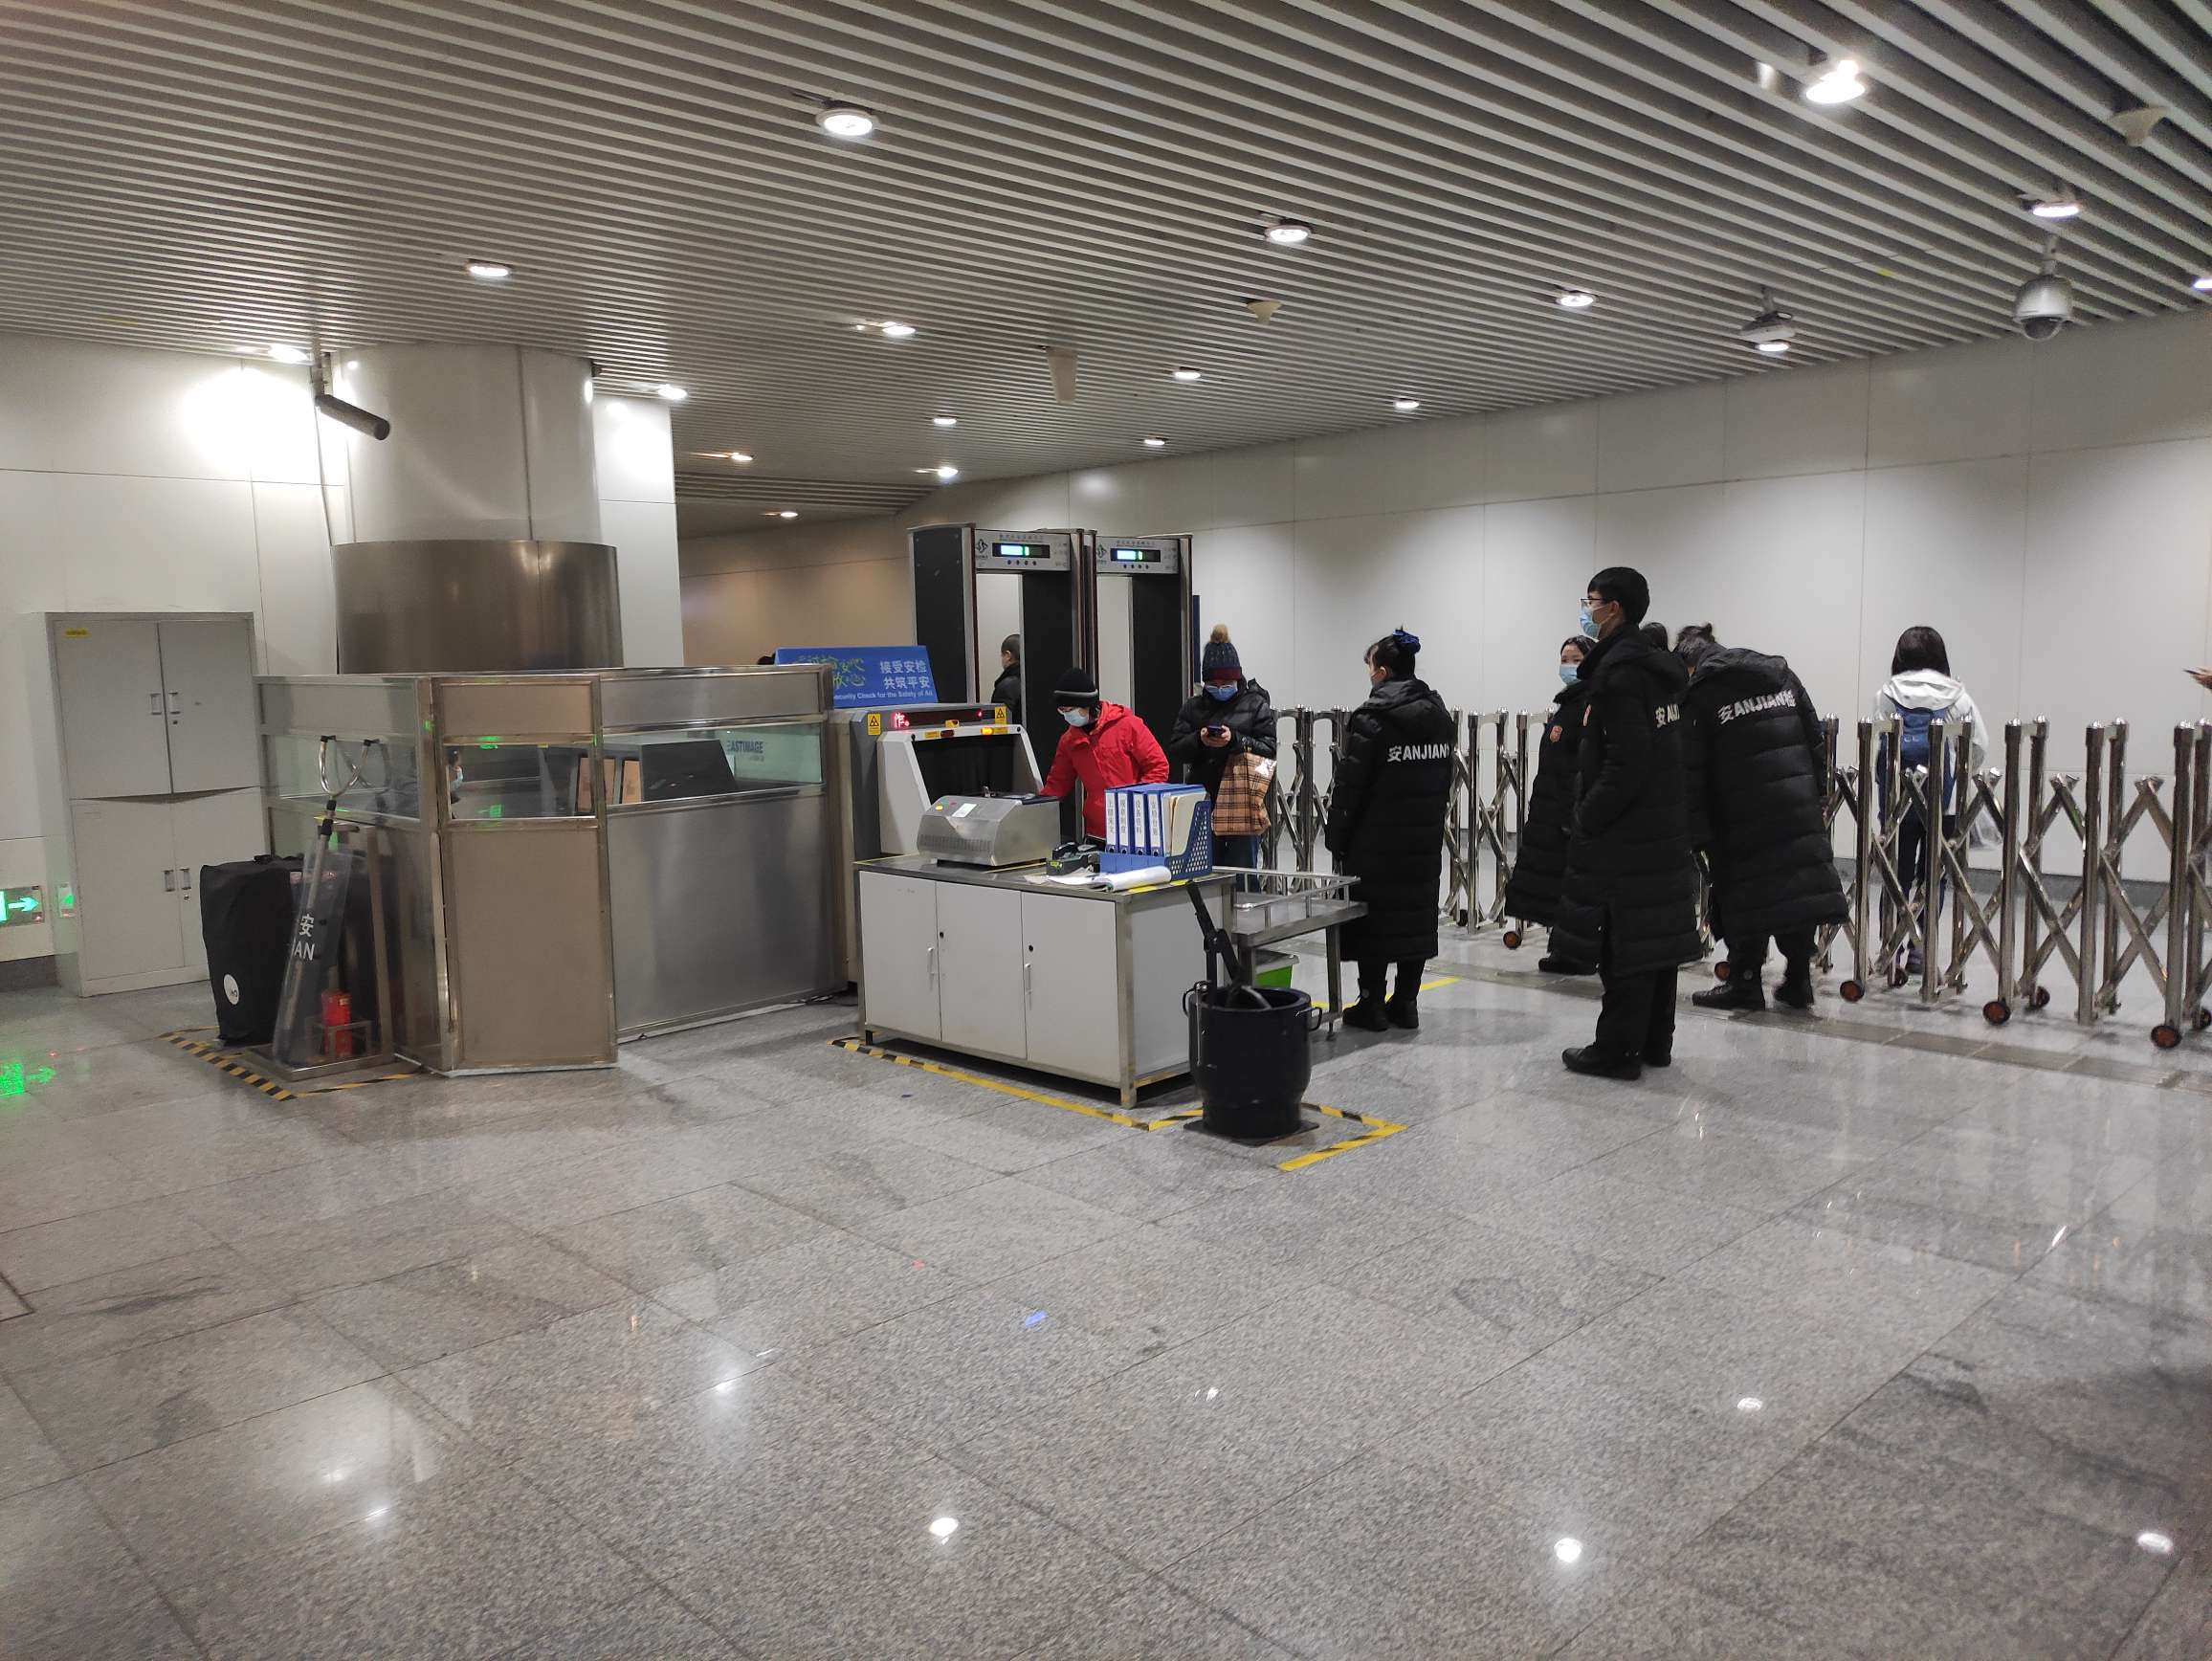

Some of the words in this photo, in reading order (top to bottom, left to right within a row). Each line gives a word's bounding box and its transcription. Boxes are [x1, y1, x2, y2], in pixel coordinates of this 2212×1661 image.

[880, 660, 927, 674] 接受安检
[883, 675, 931, 689] 共筑平安
[857, 691, 875, 699] Check
[1387, 743, 1450, 763] 安ANJIAN
[299, 914, 315, 938] 安
[294, 941, 315, 961] AN
